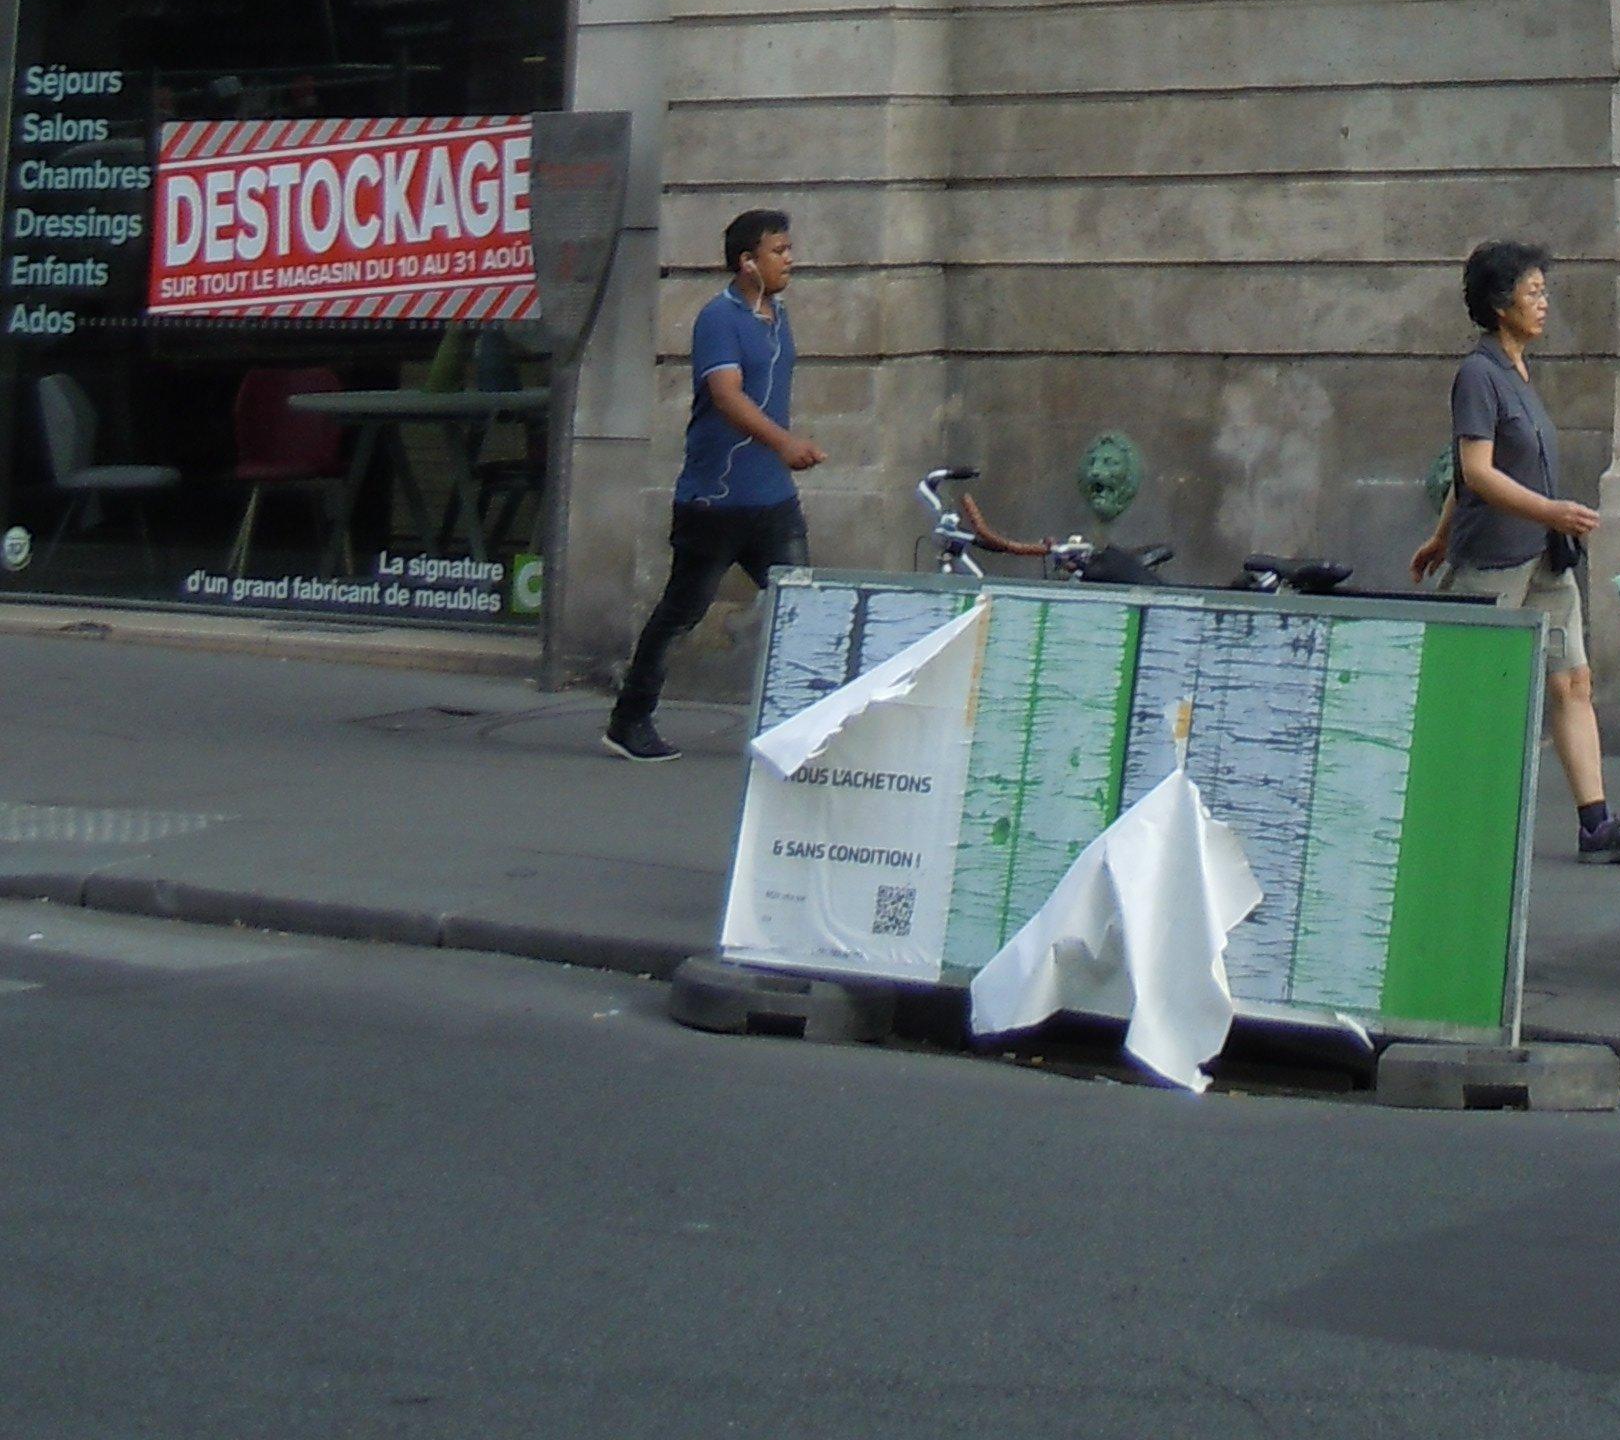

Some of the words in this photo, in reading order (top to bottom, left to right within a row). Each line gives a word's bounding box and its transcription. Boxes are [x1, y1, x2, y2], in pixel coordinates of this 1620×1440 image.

[25, 64, 123, 103] Séjours
[22, 112, 109, 143] Salons
[19, 159, 152, 191] Chambres
[165, 136, 532, 267] DESTOCKAGE
[14, 207, 143, 245] Dressings
[10, 256, 109, 286] Enfants
[160, 275, 197, 299] SUR
[202, 270, 248, 294] TOUT
[252, 268, 275, 290] LE
[277, 261, 362, 289] MAGASIN
[367, 258, 394, 281] DU
[396, 256, 418, 279] 10
[422, 253, 450, 276] AU
[453, 251, 476, 274] 31
[8, 302, 76, 335] Ados
[379, 550, 403, 575] La
[408, 553, 504, 582] signature
[186, 569, 228, 595] d'un
[232, 574, 288, 601] grand
[293, 577, 381, 606] fabricant
[385, 582, 411, 607] de
[415, 587, 502, 613] meubles
[832, 768, 933, 794] L'ACHETONS
[786, 839, 825, 860] SANS
[828, 844, 913, 869] CONDITION
